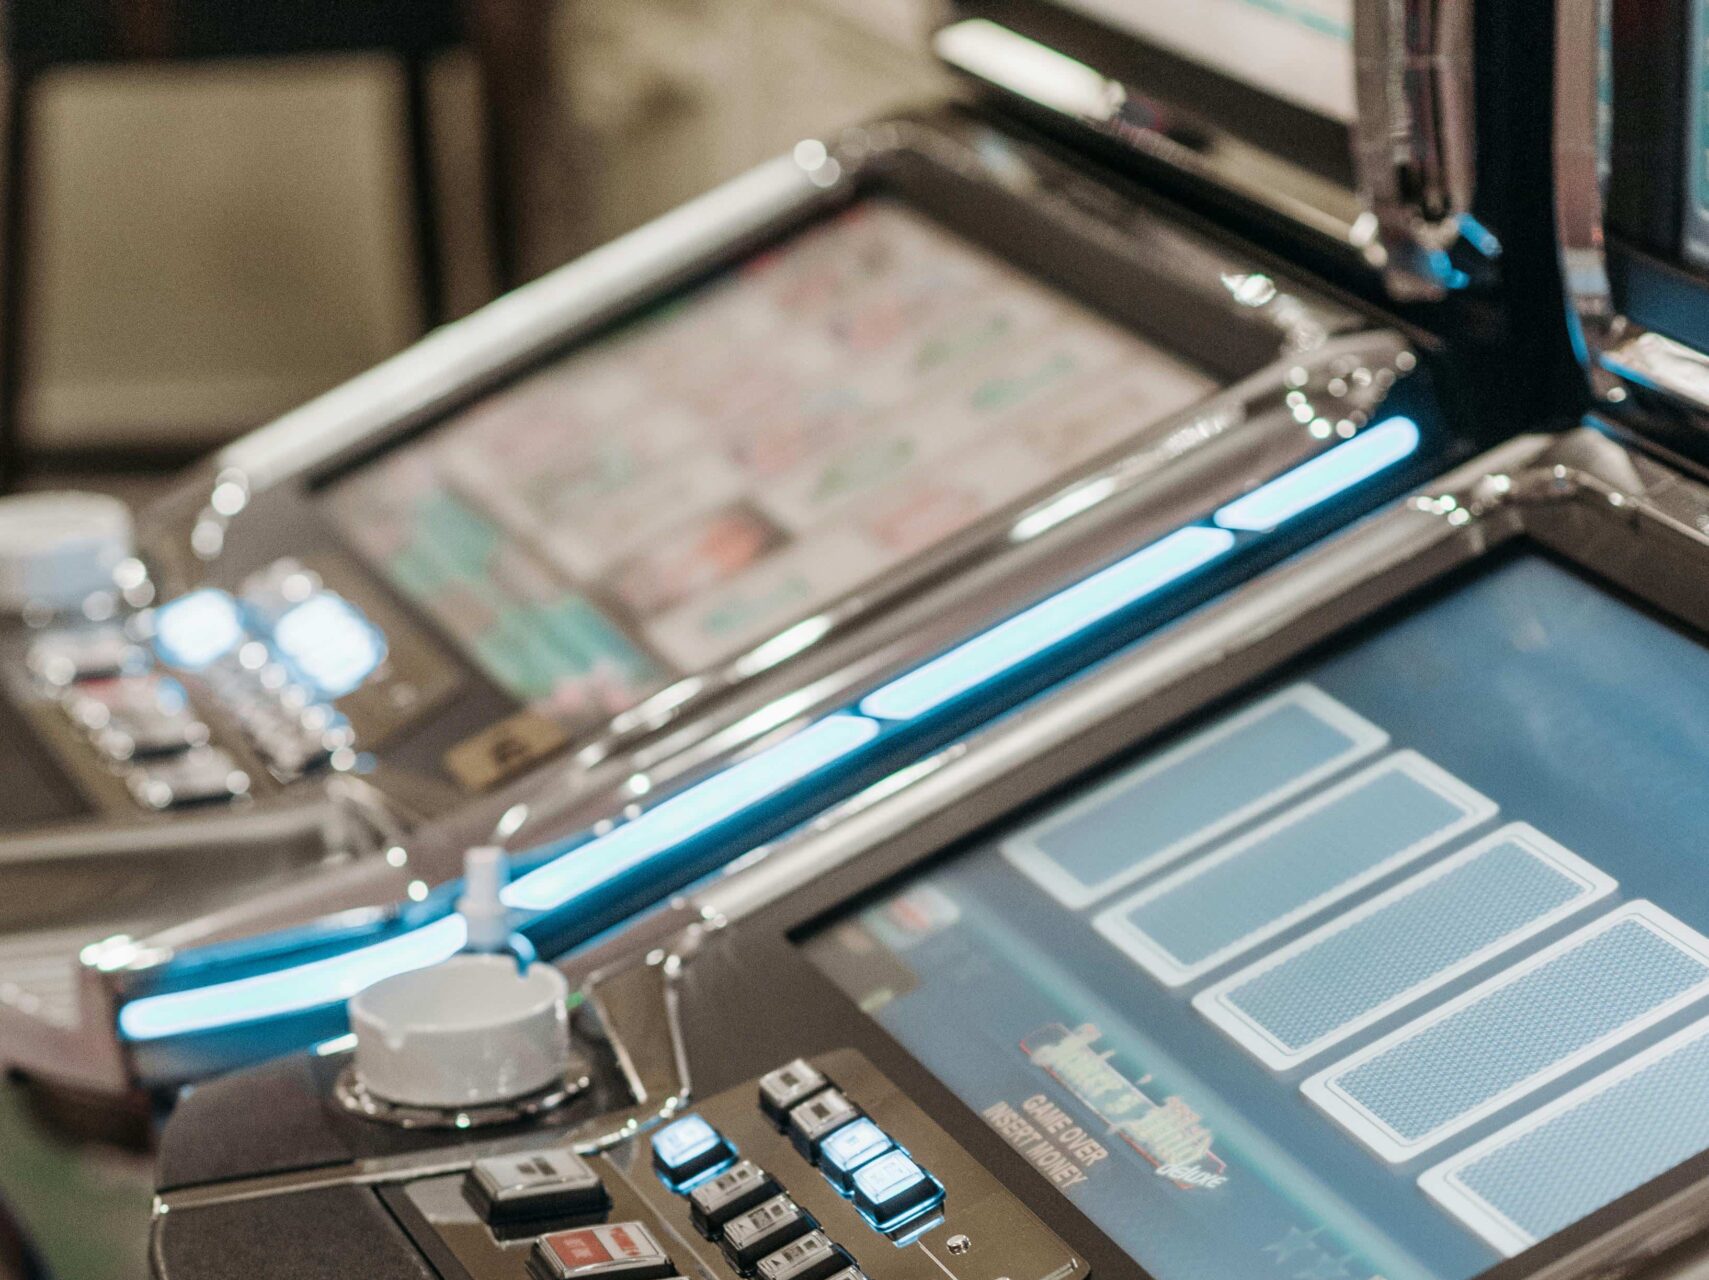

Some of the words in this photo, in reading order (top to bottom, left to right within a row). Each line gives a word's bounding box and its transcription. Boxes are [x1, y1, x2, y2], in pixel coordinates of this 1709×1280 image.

[981, 1101, 1043, 1148] INSERT
[1024, 1141, 1088, 1188] MONEY
[1022, 1094, 1073, 1134] GAME
[1059, 1126, 1109, 1167] OVER
